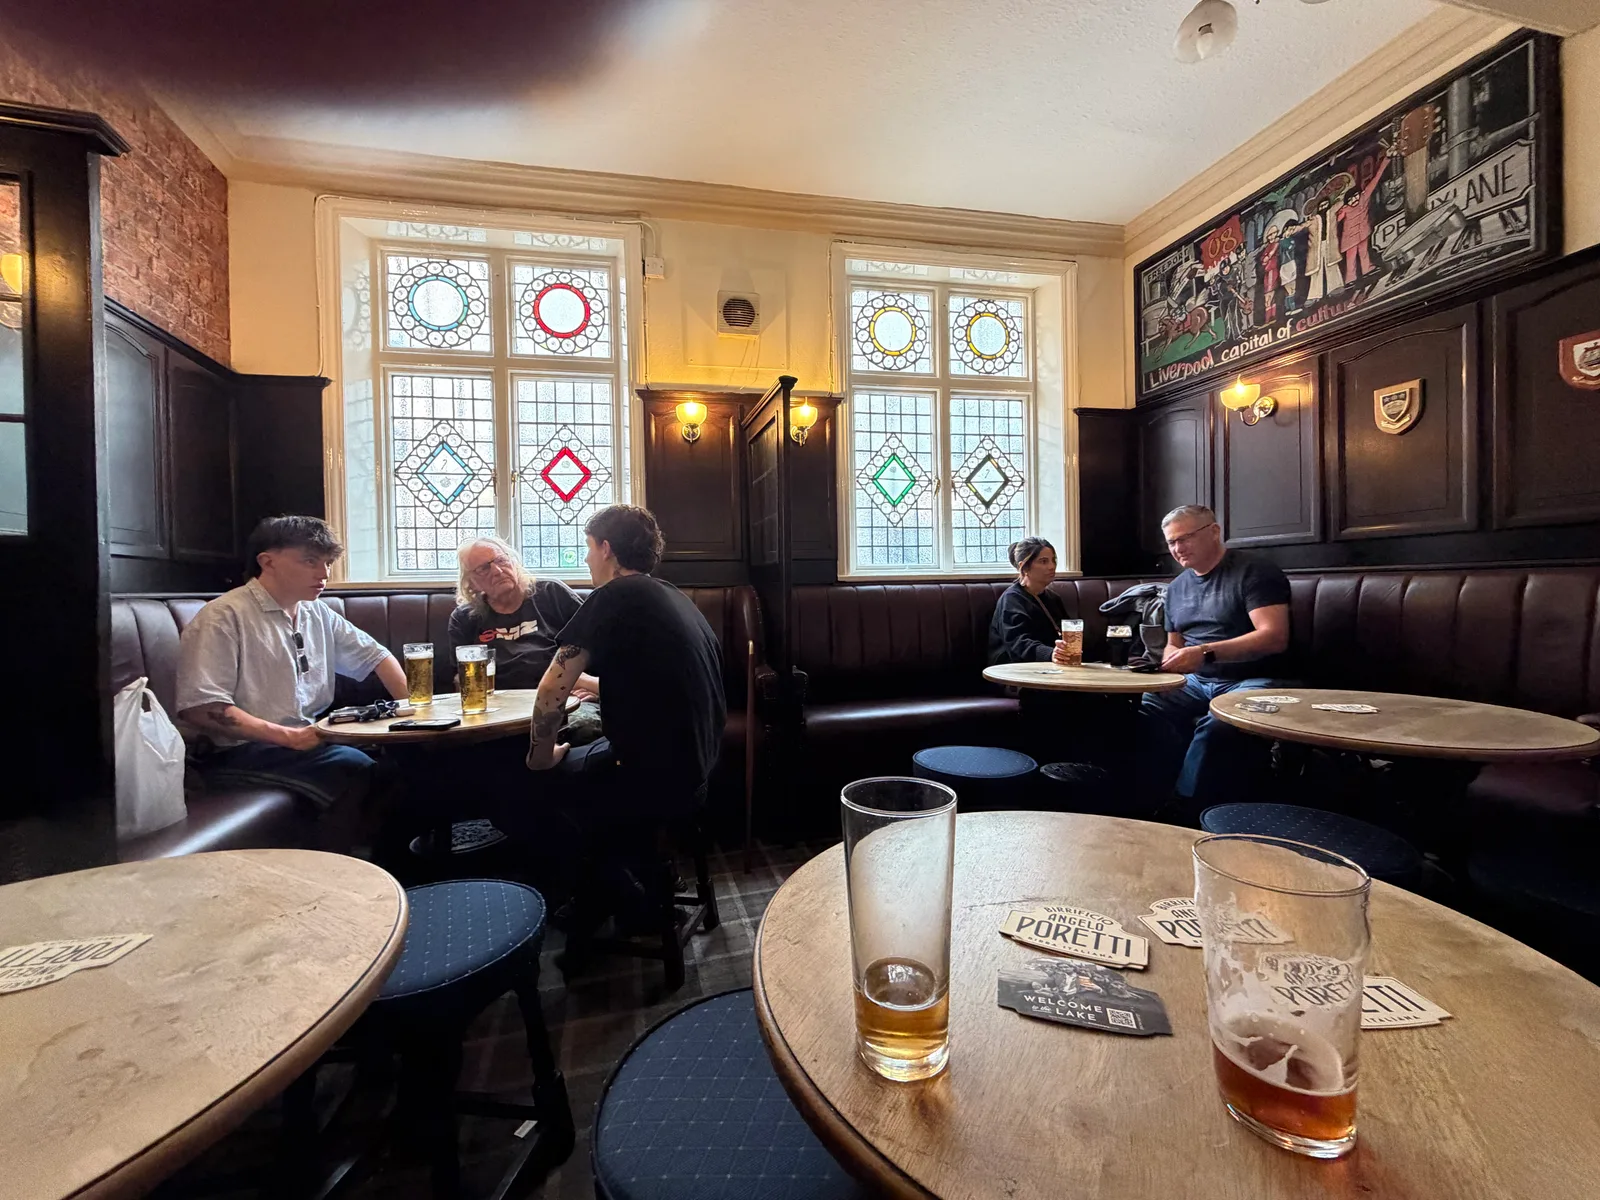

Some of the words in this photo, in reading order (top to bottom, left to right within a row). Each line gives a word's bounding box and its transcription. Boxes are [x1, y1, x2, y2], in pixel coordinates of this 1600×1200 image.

[1208, 227, 1238, 259] 08
[1149, 348, 1215, 388] Liverpool
[1221, 328, 1273, 356] capital
[1276, 318, 1294, 339] of
[1043, 906, 1114, 926] BIRRIFICIO
[1048, 913, 1104, 931] ANGELO
[1015, 916, 1131, 957] PORETTI
[1028, 936, 1057, 947] BIRRA
[1063, 945, 1113, 959] ITALIANA
[1023, 994, 1103, 1013] WELCOME
[1055, 1008, 1097, 1022] LAKE
[1365, 1015, 1421, 1023] ITALIANA
